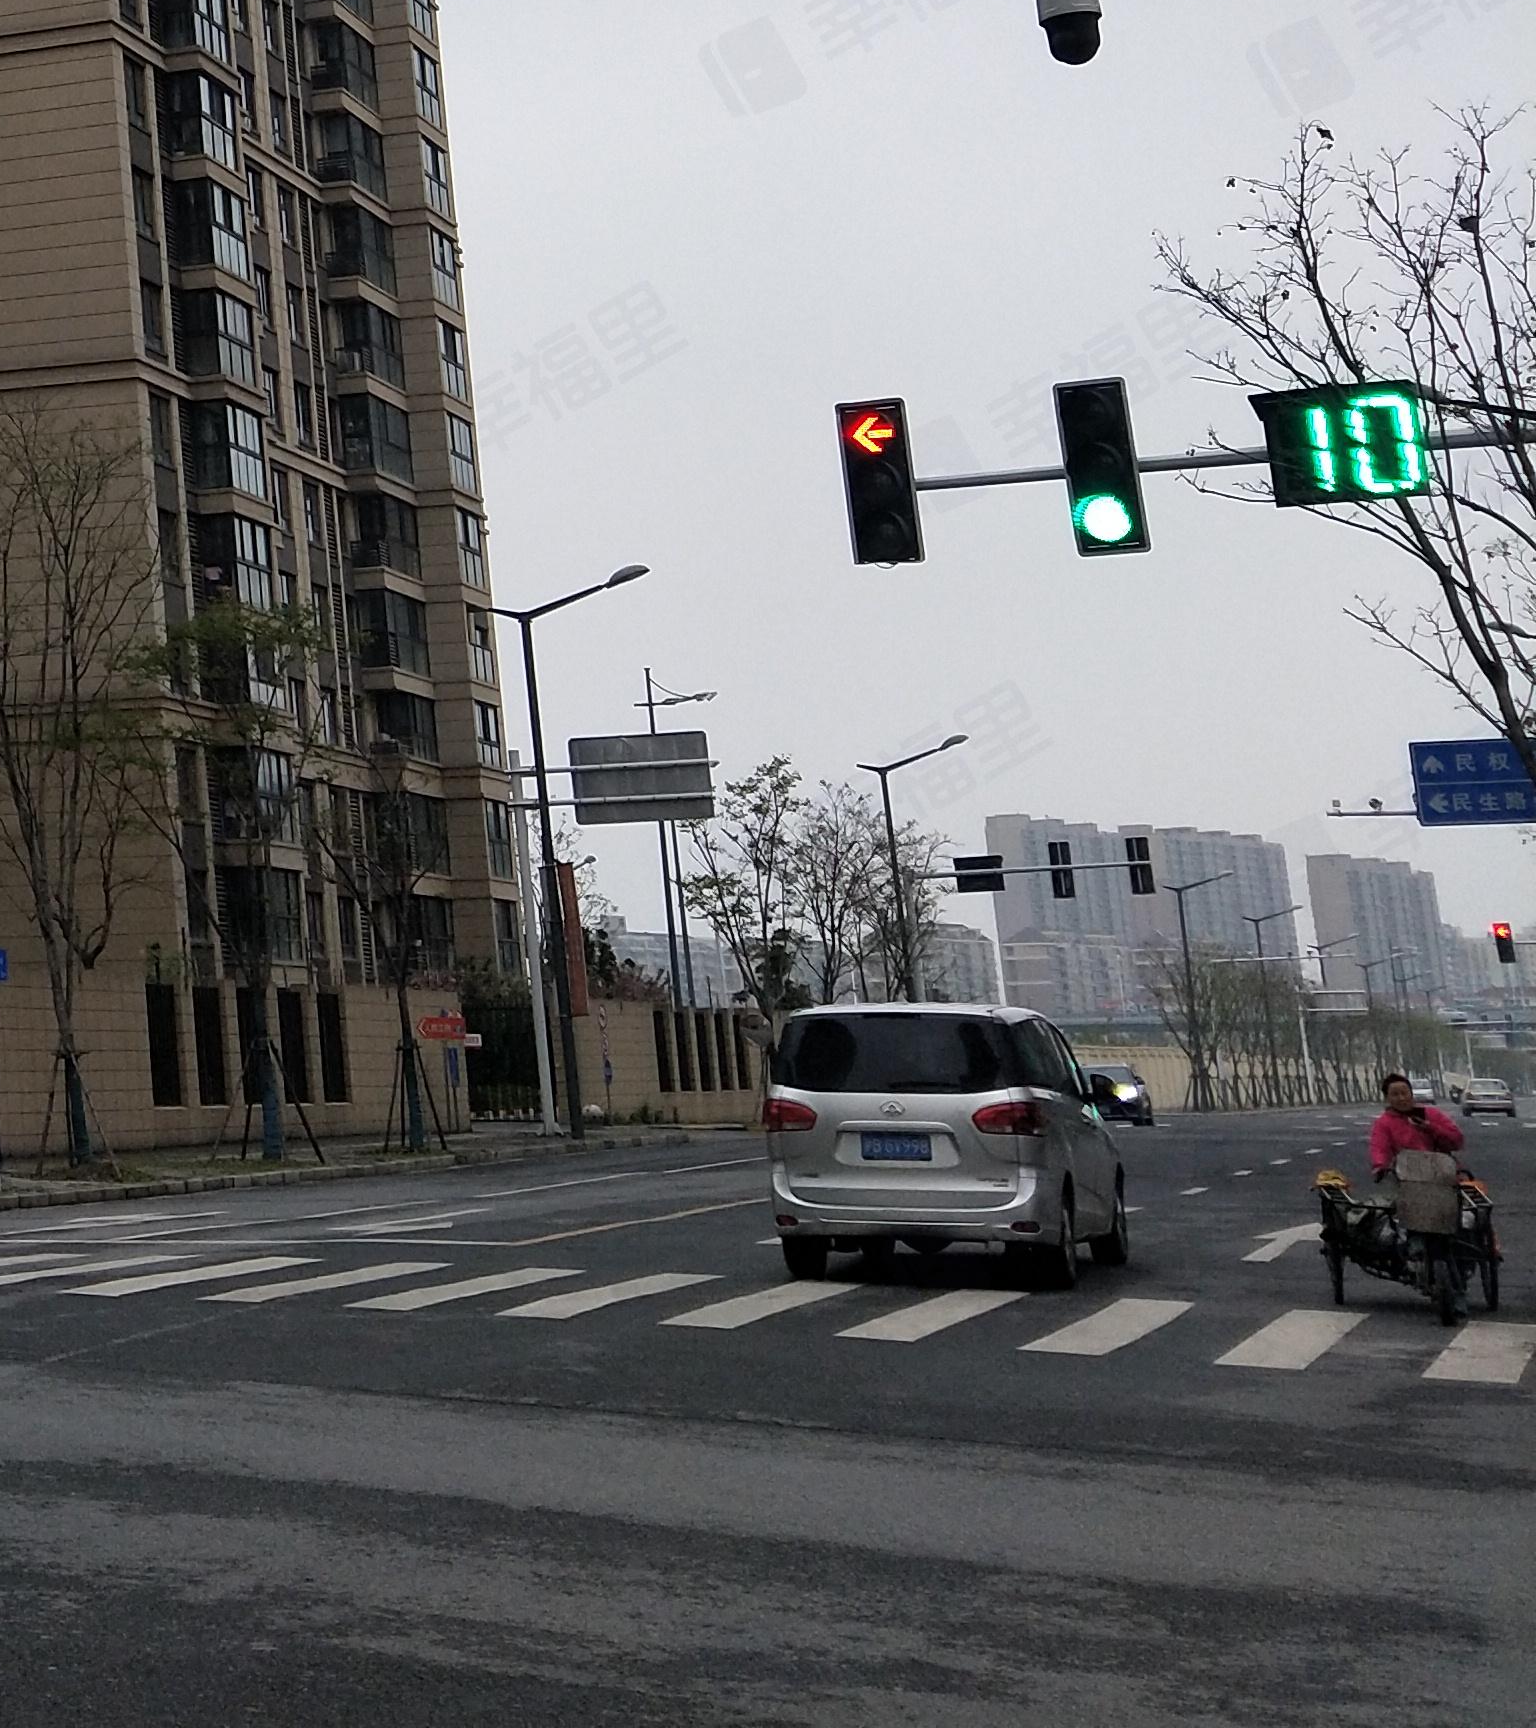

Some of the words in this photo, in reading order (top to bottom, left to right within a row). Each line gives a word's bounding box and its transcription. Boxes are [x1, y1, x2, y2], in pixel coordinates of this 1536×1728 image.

[1305, 392, 1421, 494] 10
[1455, 752, 1510, 772] 民权
[1452, 791, 1526, 811] 民生路
